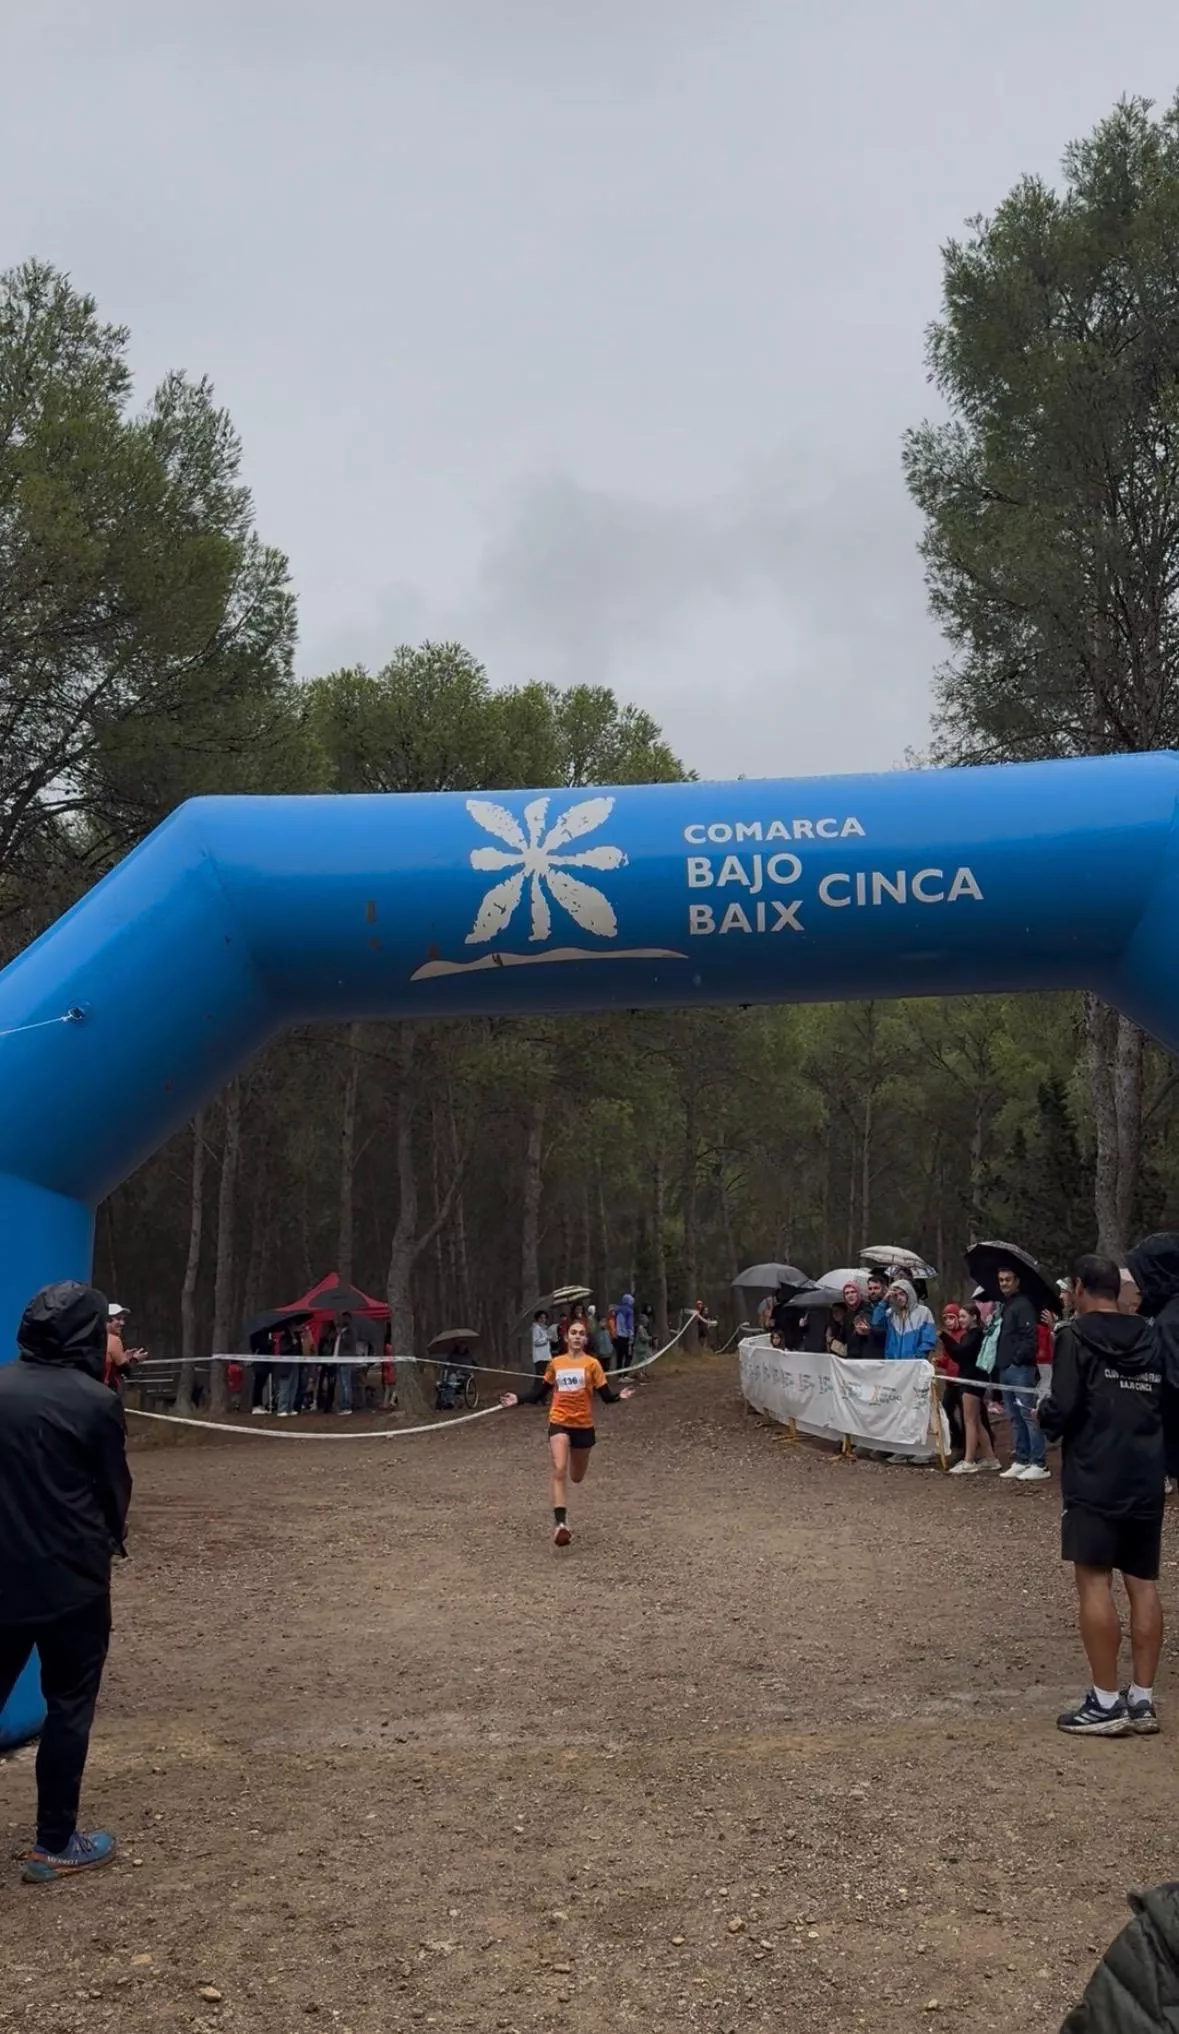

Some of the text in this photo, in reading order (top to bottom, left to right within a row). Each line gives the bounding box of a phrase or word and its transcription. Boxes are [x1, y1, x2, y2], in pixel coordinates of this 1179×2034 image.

[684, 817, 866, 844] COMARCA
[687, 853, 802, 894] BAJO
[818, 867, 984, 907] CINCA
[689, 900, 805, 935] BAIX
